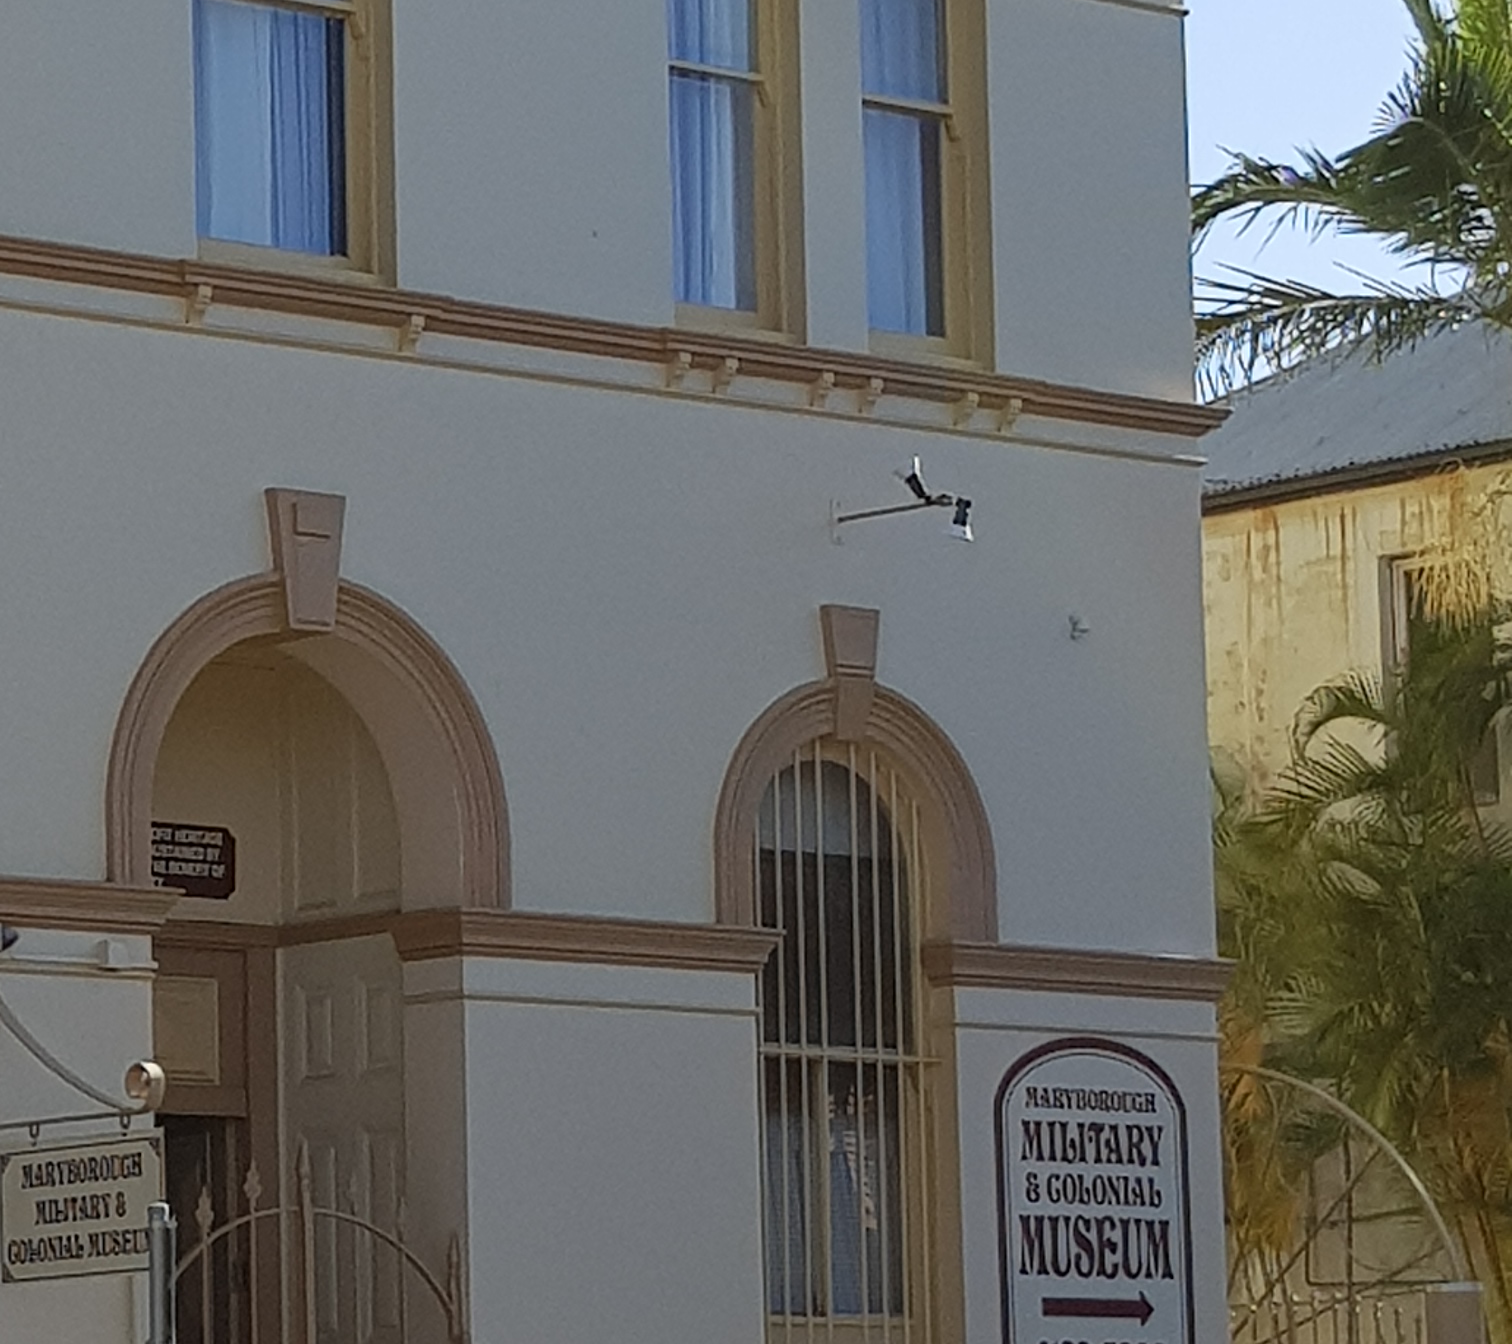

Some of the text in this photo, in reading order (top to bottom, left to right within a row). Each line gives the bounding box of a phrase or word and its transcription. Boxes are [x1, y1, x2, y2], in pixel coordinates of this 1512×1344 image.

[1025, 1086, 1157, 1114] MARYBOROUGH
[1020, 1118, 1164, 1168] MILITARY
[21, 1152, 143, 1189] MARYBOROUGH
[35, 1191, 127, 1226] MILITARY &
[1025, 1172, 1162, 1209] & COLONIAL
[7, 1233, 85, 1265] COLONIAL
[1018, 1214, 1175, 1280] MUSEUM
